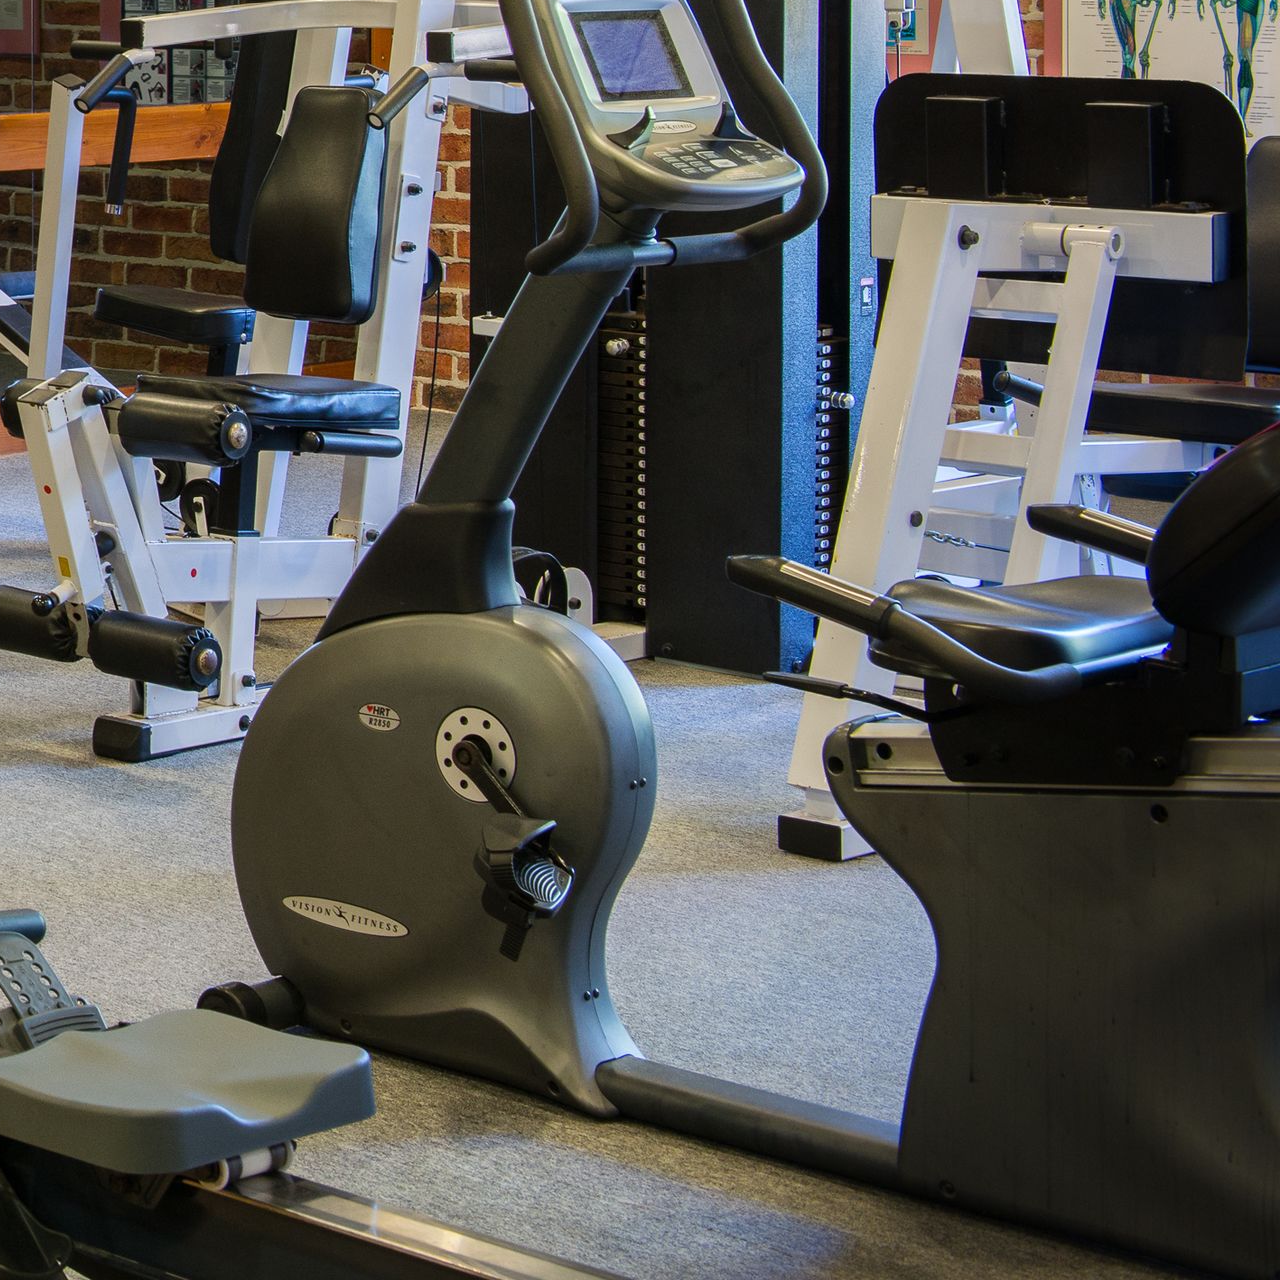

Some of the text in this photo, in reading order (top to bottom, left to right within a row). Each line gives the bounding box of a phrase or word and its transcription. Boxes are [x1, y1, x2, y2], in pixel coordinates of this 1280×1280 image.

[372, 705, 390, 716] HRT
[292, 900, 399, 933] VISION FITNESS
